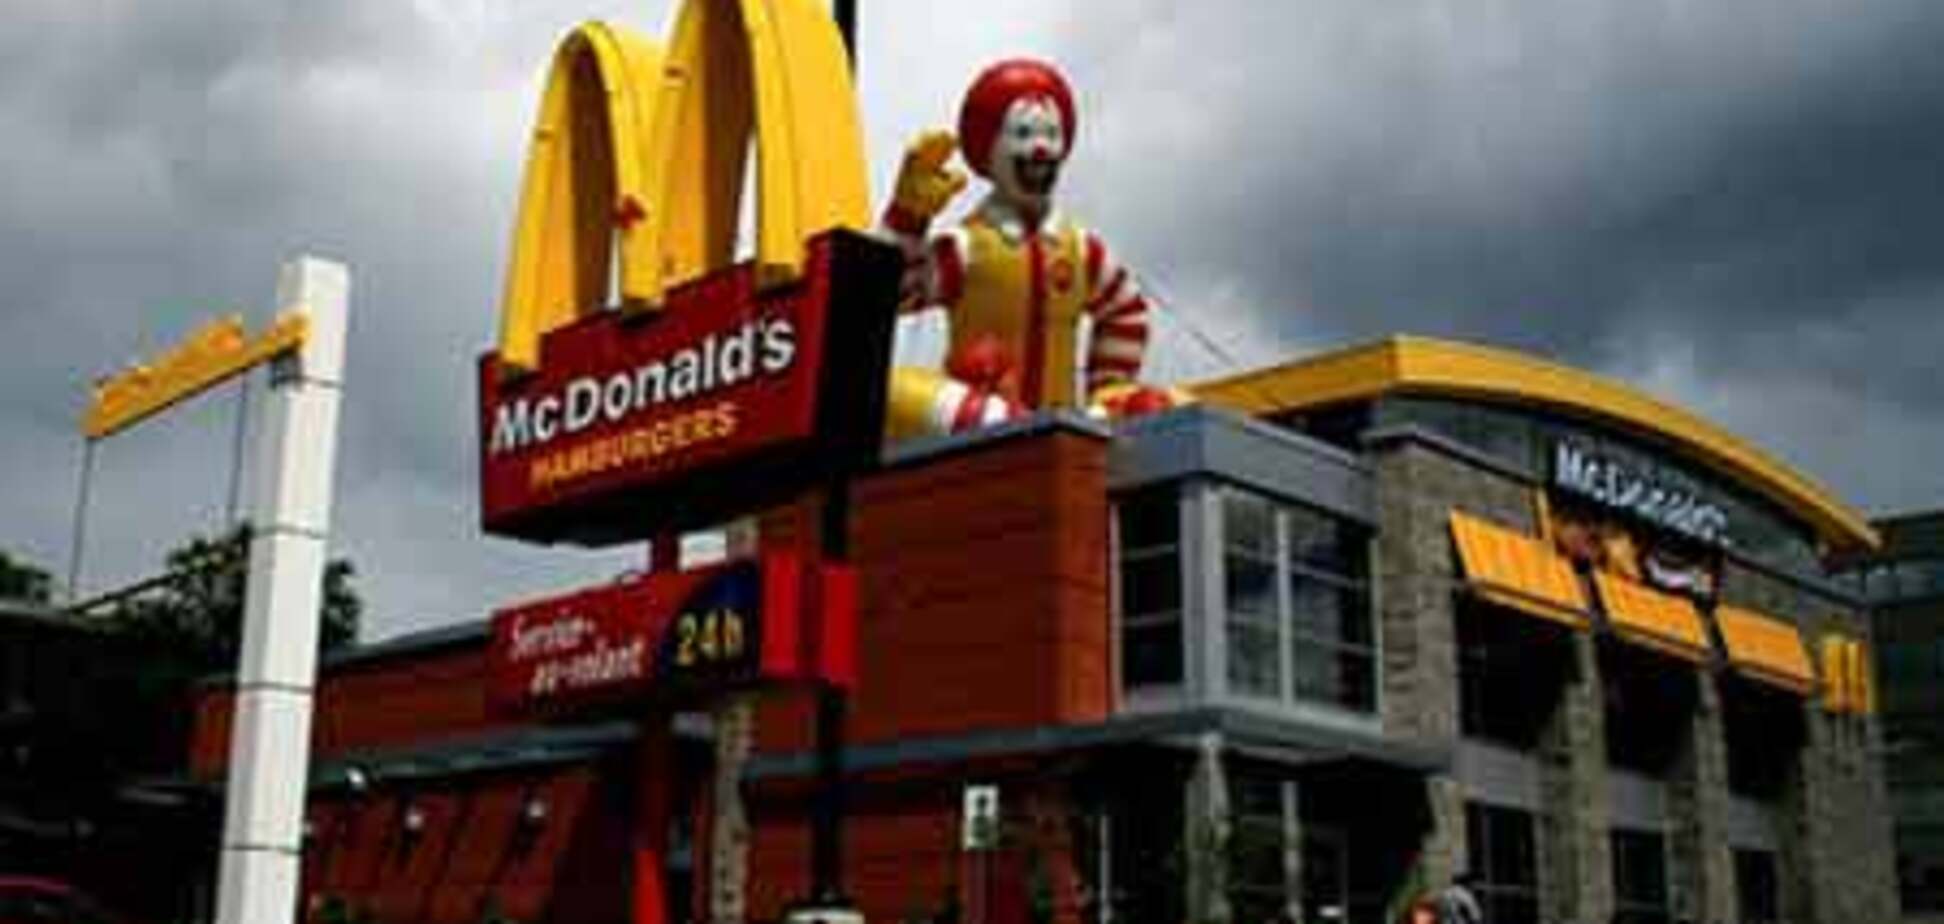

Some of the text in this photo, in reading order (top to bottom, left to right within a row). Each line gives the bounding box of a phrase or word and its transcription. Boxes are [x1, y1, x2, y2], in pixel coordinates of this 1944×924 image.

[489, 318, 796, 456] McDonald's
[531, 402, 738, 488] HAMBURGERS
[675, 610, 744, 666] 24h
